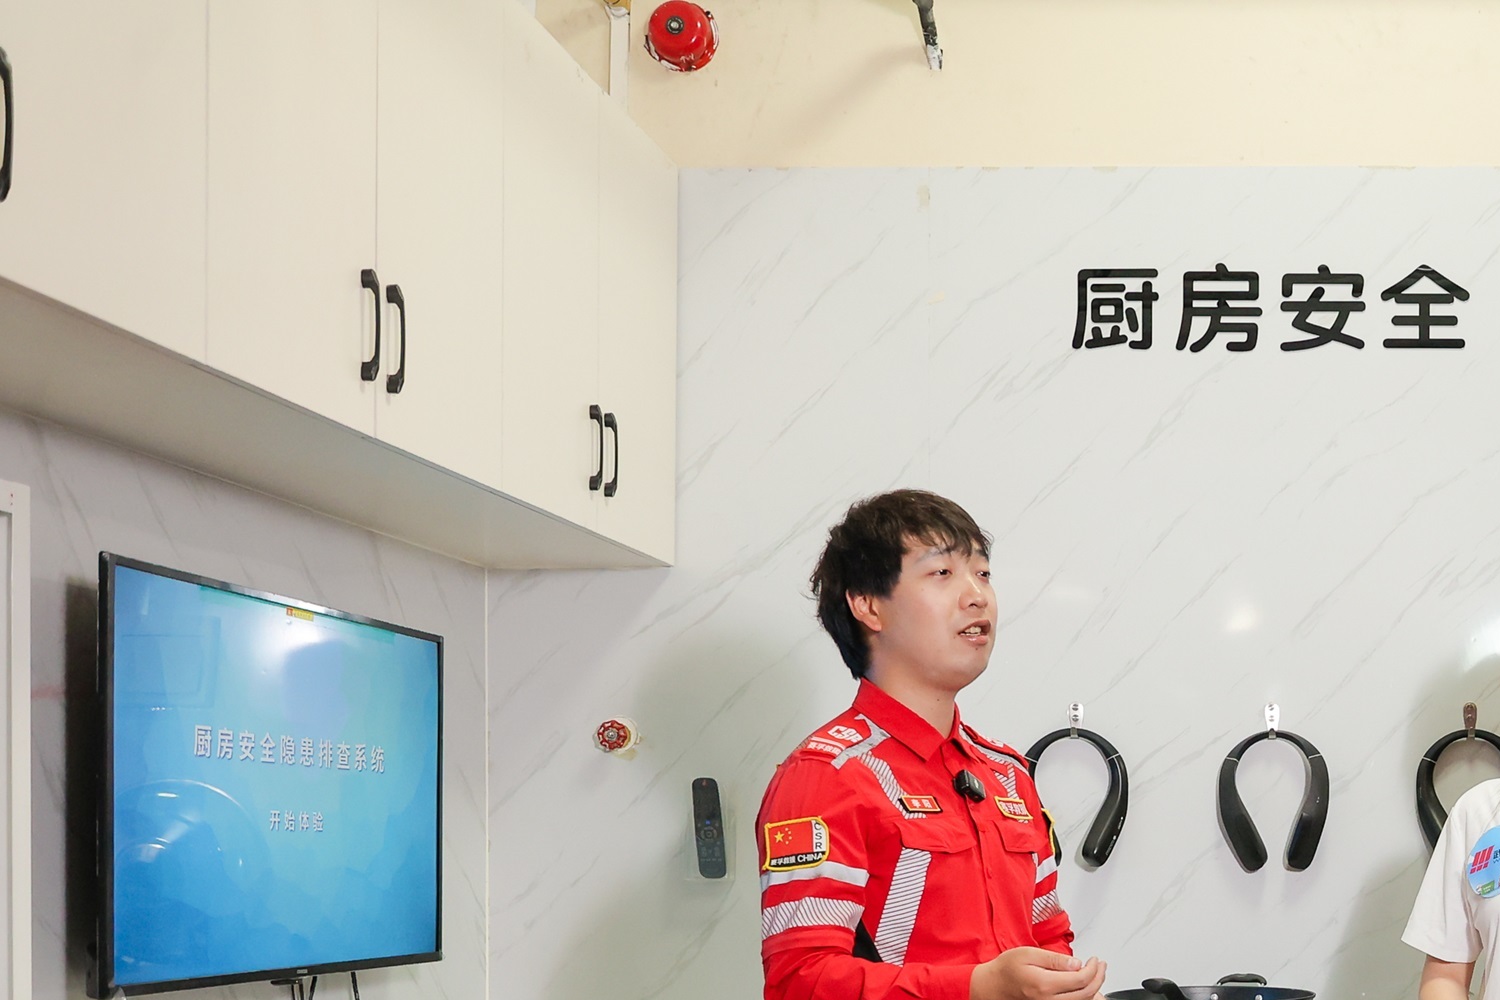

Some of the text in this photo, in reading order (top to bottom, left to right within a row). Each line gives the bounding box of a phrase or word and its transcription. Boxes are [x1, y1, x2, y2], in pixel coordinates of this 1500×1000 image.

[1072, 262, 1471, 353] 厨房安全
[193, 724, 386, 774] 厨房安全隐患排查系统
[269, 809, 325, 833] 开始体验
[814, 821, 823, 850] CSR
[797, 852, 824, 862] CHINA
